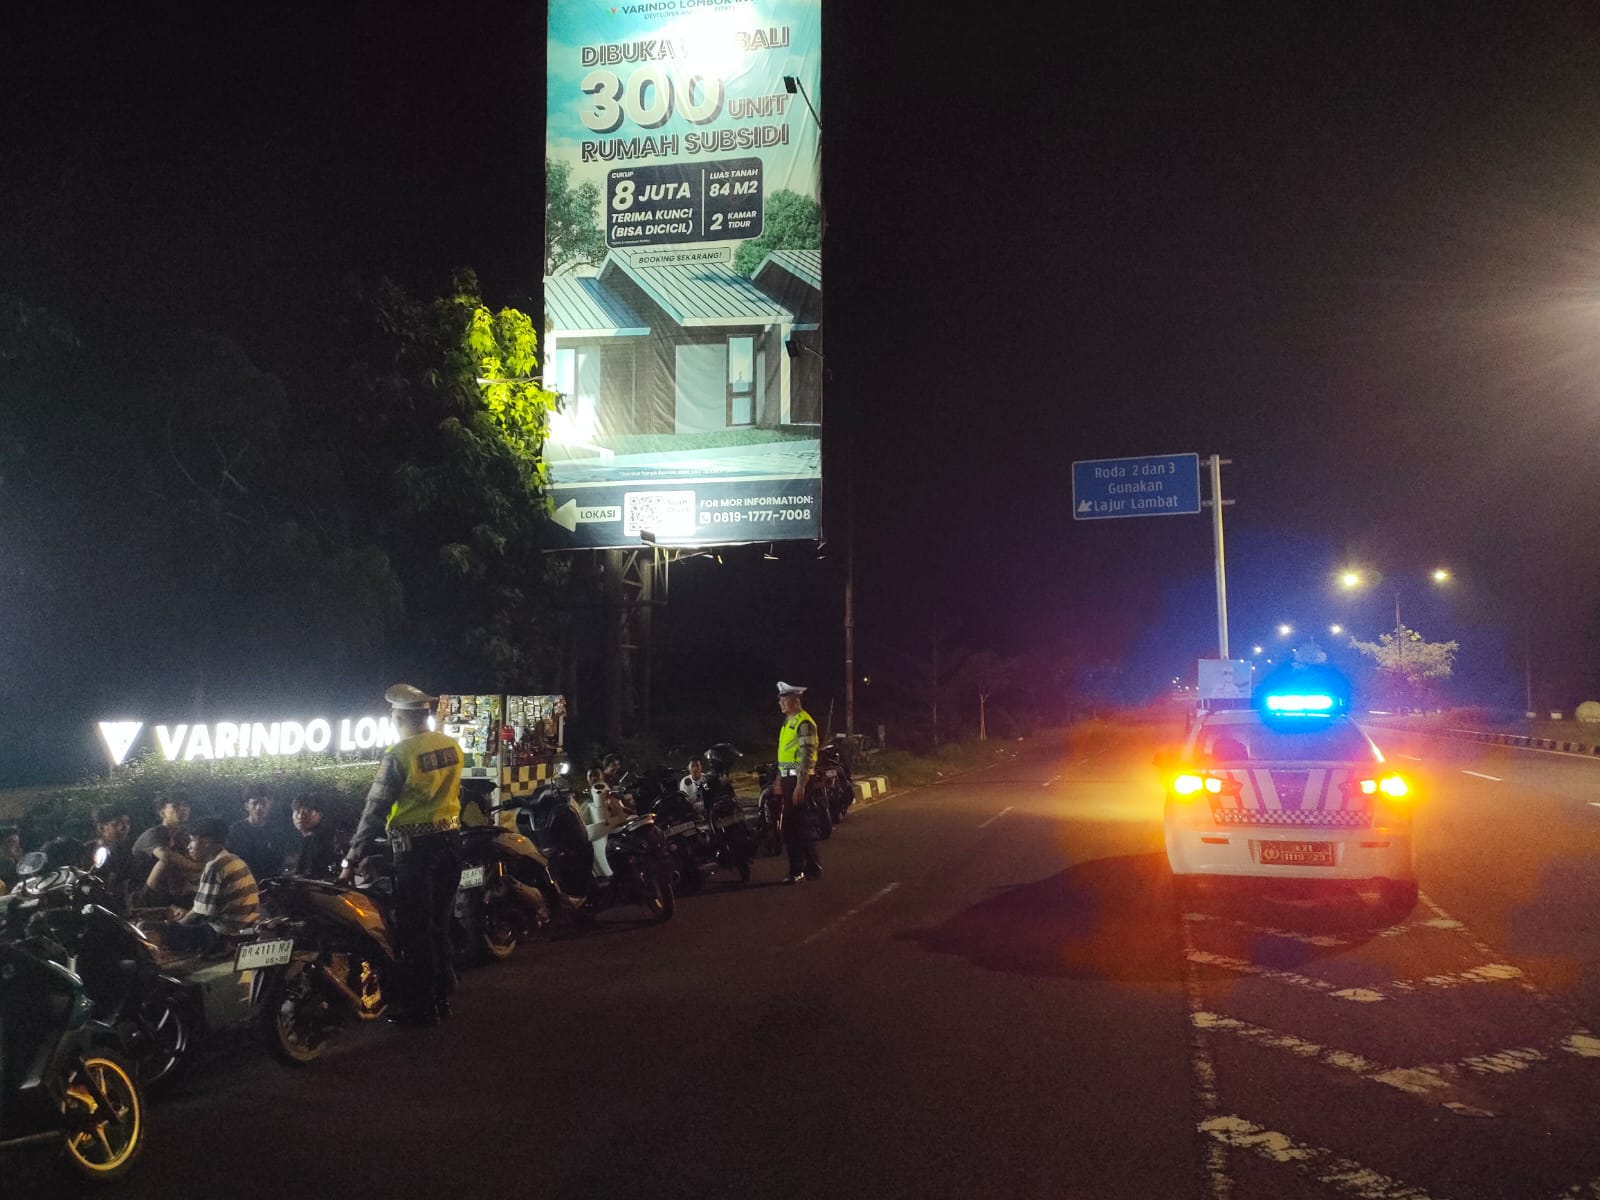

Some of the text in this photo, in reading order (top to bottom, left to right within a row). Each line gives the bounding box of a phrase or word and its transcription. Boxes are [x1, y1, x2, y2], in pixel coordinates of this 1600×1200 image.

[622, 1, 677, 15] VARINDO
[581, 39, 676, 66] DIBUKA
[580, 66, 789, 134] 300 UNIT
[582, 124, 790, 162] RUMAH SUBSIDI
[611, 171, 634, 179] CUKUP
[709, 169, 758, 180] LUAS TANAH
[611, 180, 691, 211] 8 JUTA
[709, 180, 759, 197] 84 M2
[611, 208, 693, 223] TERIMA KUNCI
[710, 213, 724, 231] 2
[727, 210, 757, 220] KAMAR
[611, 220, 693, 240] (BISA DICICIL)
[727, 221, 751, 229] TIDUR
[638, 252, 722, 264] BOOKING SEKARANG!
[1095, 462, 1176, 479] Roda 2 dan 3
[1108, 480, 1163, 494] Gunakan
[700, 495, 814, 508] FOR MOR INFORMATION:
[1094, 495, 1178, 512] Lajur Lambat
[580, 509, 616, 519] LOKASI
[713, 509, 811, 523] 0819-1777-7008
[155, 716, 401, 761] VARINDO LOM
[254, 944, 276, 956] 4111
